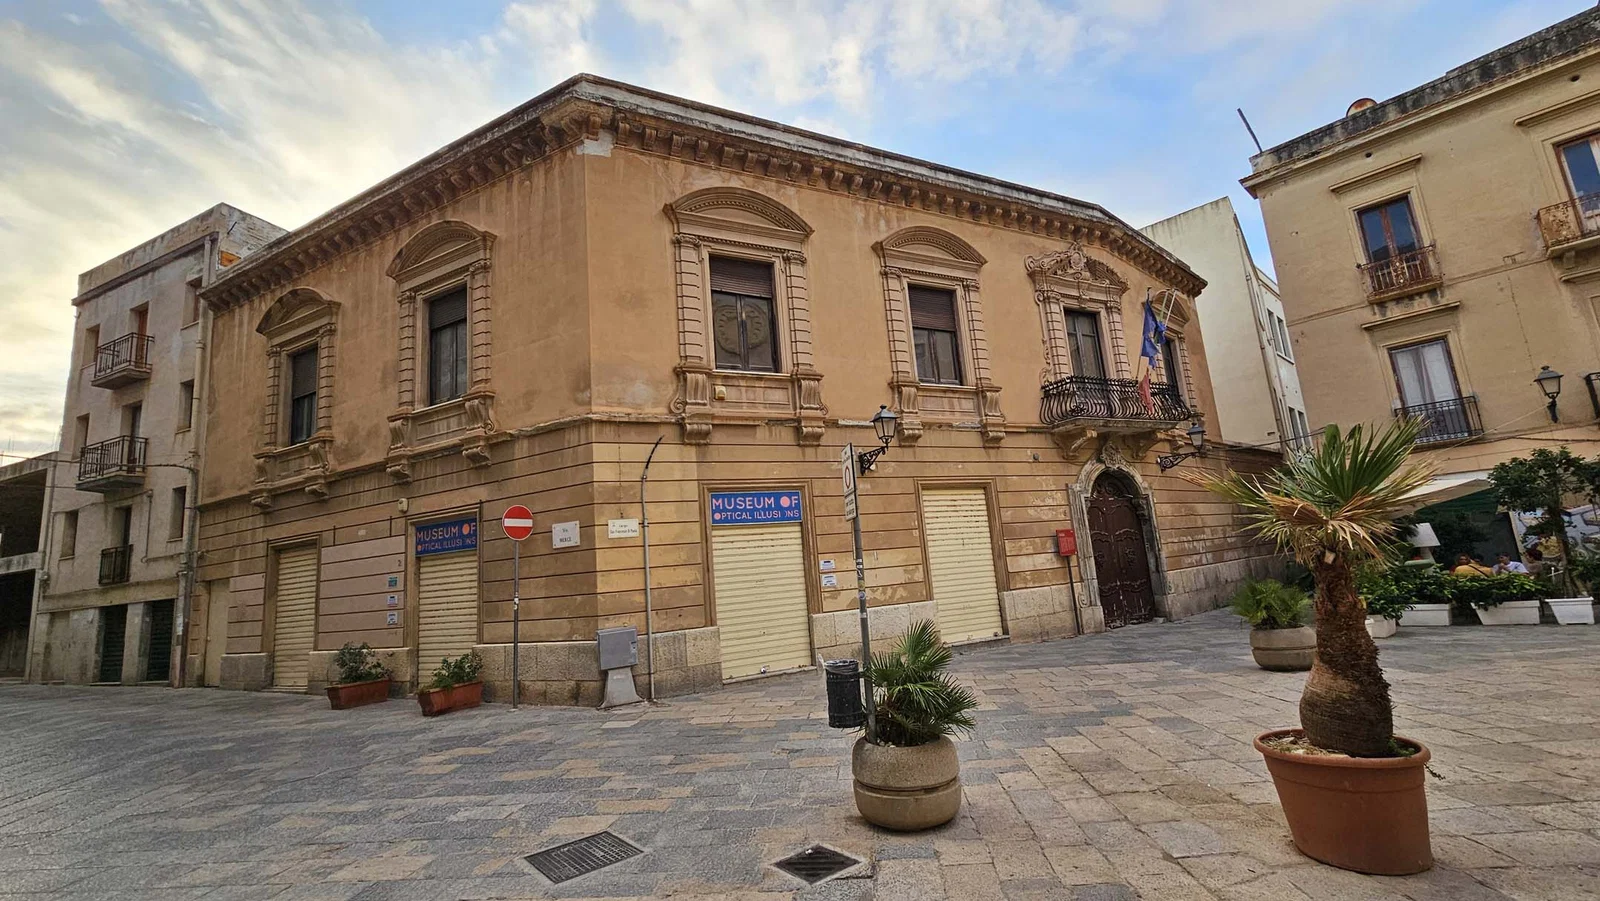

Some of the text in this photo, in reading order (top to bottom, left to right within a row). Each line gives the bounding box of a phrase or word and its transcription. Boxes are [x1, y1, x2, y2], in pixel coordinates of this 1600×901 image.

[712, 495, 798, 509] MUSEUM OF
[714, 511, 752, 520] OPTICAL
[416, 522, 476, 542] MUSEUM OF
[417, 536, 476, 552] OPTICAL ILLUSINS
